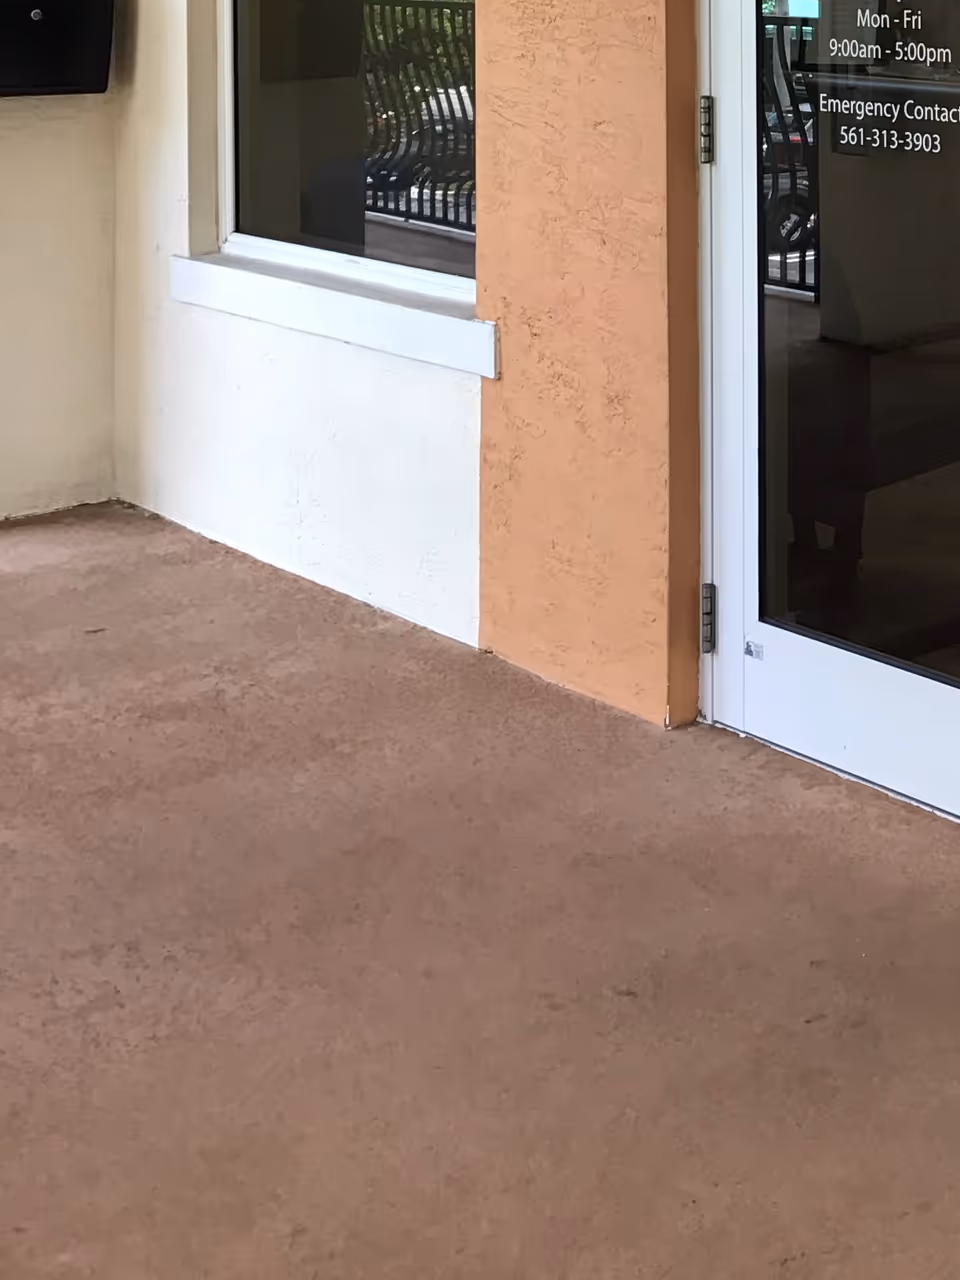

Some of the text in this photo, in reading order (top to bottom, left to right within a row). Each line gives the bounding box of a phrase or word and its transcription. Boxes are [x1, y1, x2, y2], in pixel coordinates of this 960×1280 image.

[856, 9, 890, 29] Mon
[903, 9, 922, 30] Fri
[829, 38, 882, 59] 9:00am
[894, 42, 952, 66] 5:00pm
[819, 93, 900, 123] Emergency
[839, 126, 941, 153] 561-313-3903
